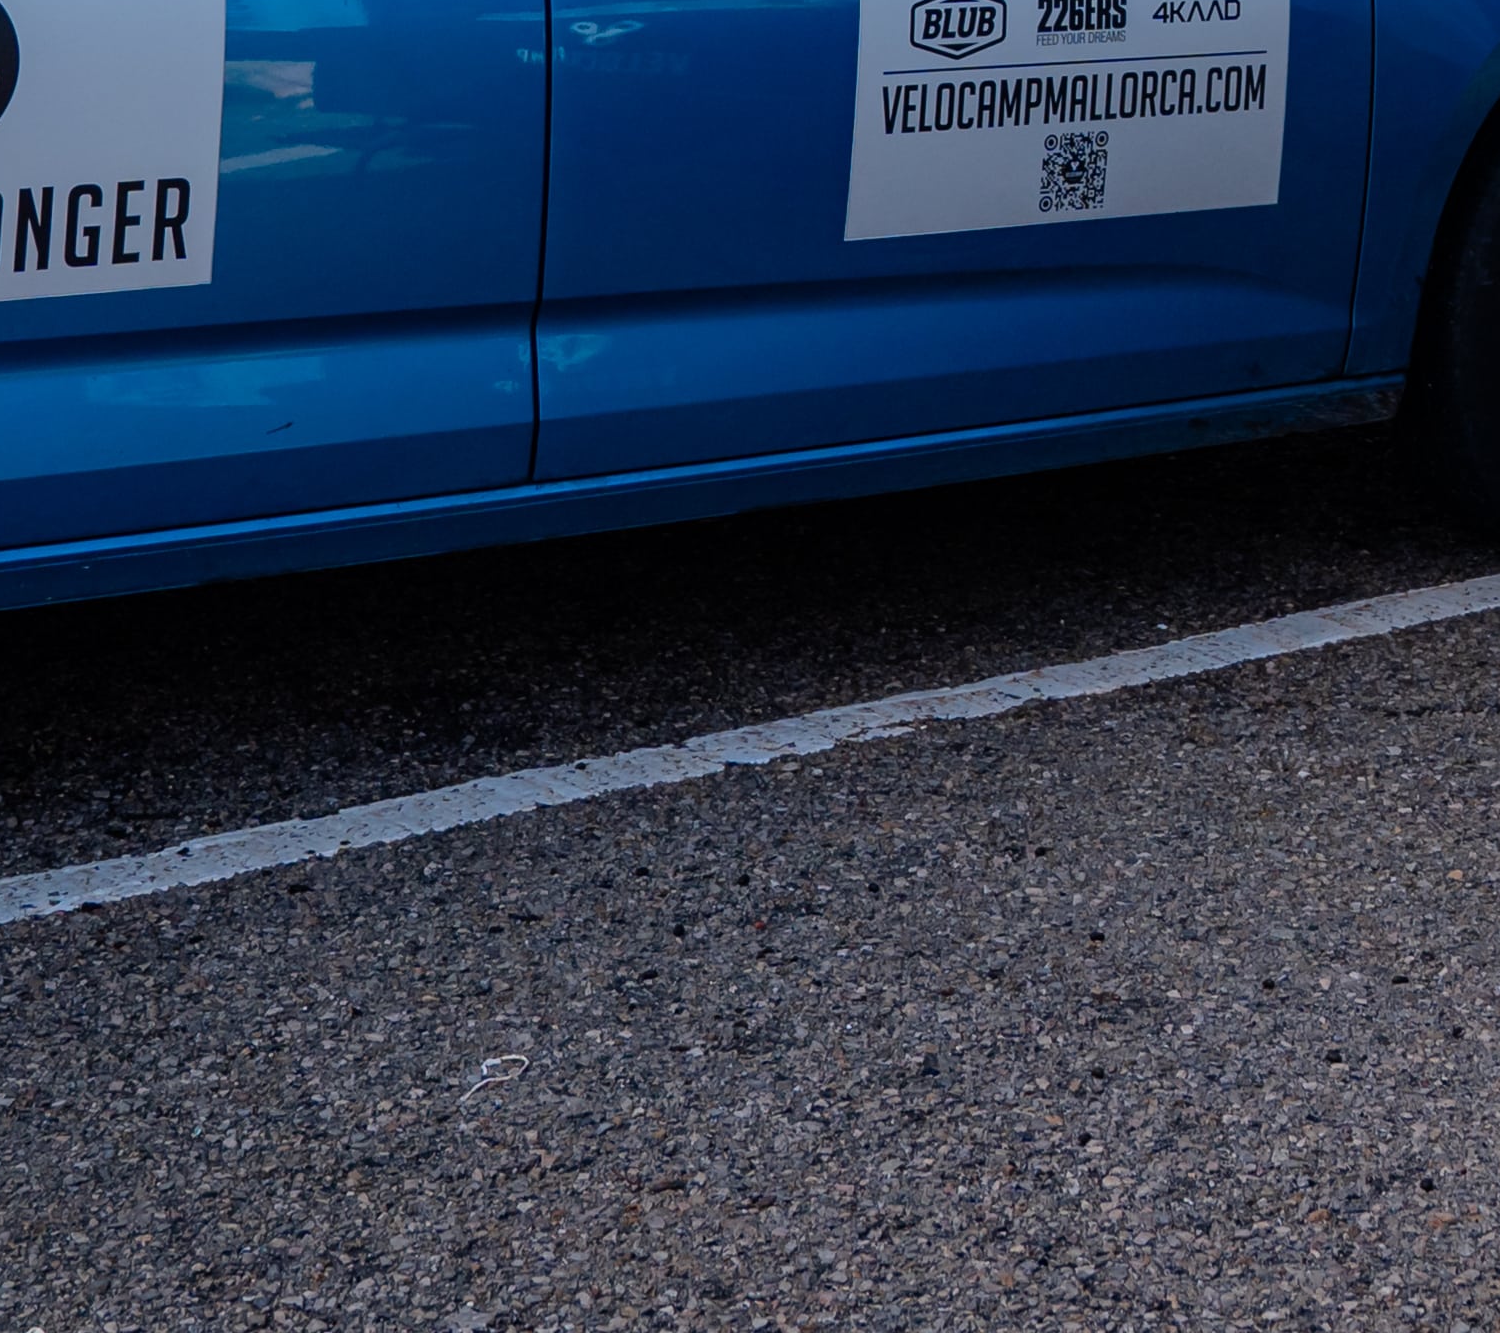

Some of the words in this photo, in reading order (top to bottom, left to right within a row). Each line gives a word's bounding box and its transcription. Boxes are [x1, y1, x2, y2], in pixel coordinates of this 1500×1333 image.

[922, 6, 997, 40] BLUB
[1036, 34, 1059, 47] FEED
[1061, 32, 1086, 45] YOUR
[1088, 30, 1126, 44] DREAMS
[882, 64, 1267, 134] VELOCAMPMALLORCA.COM
